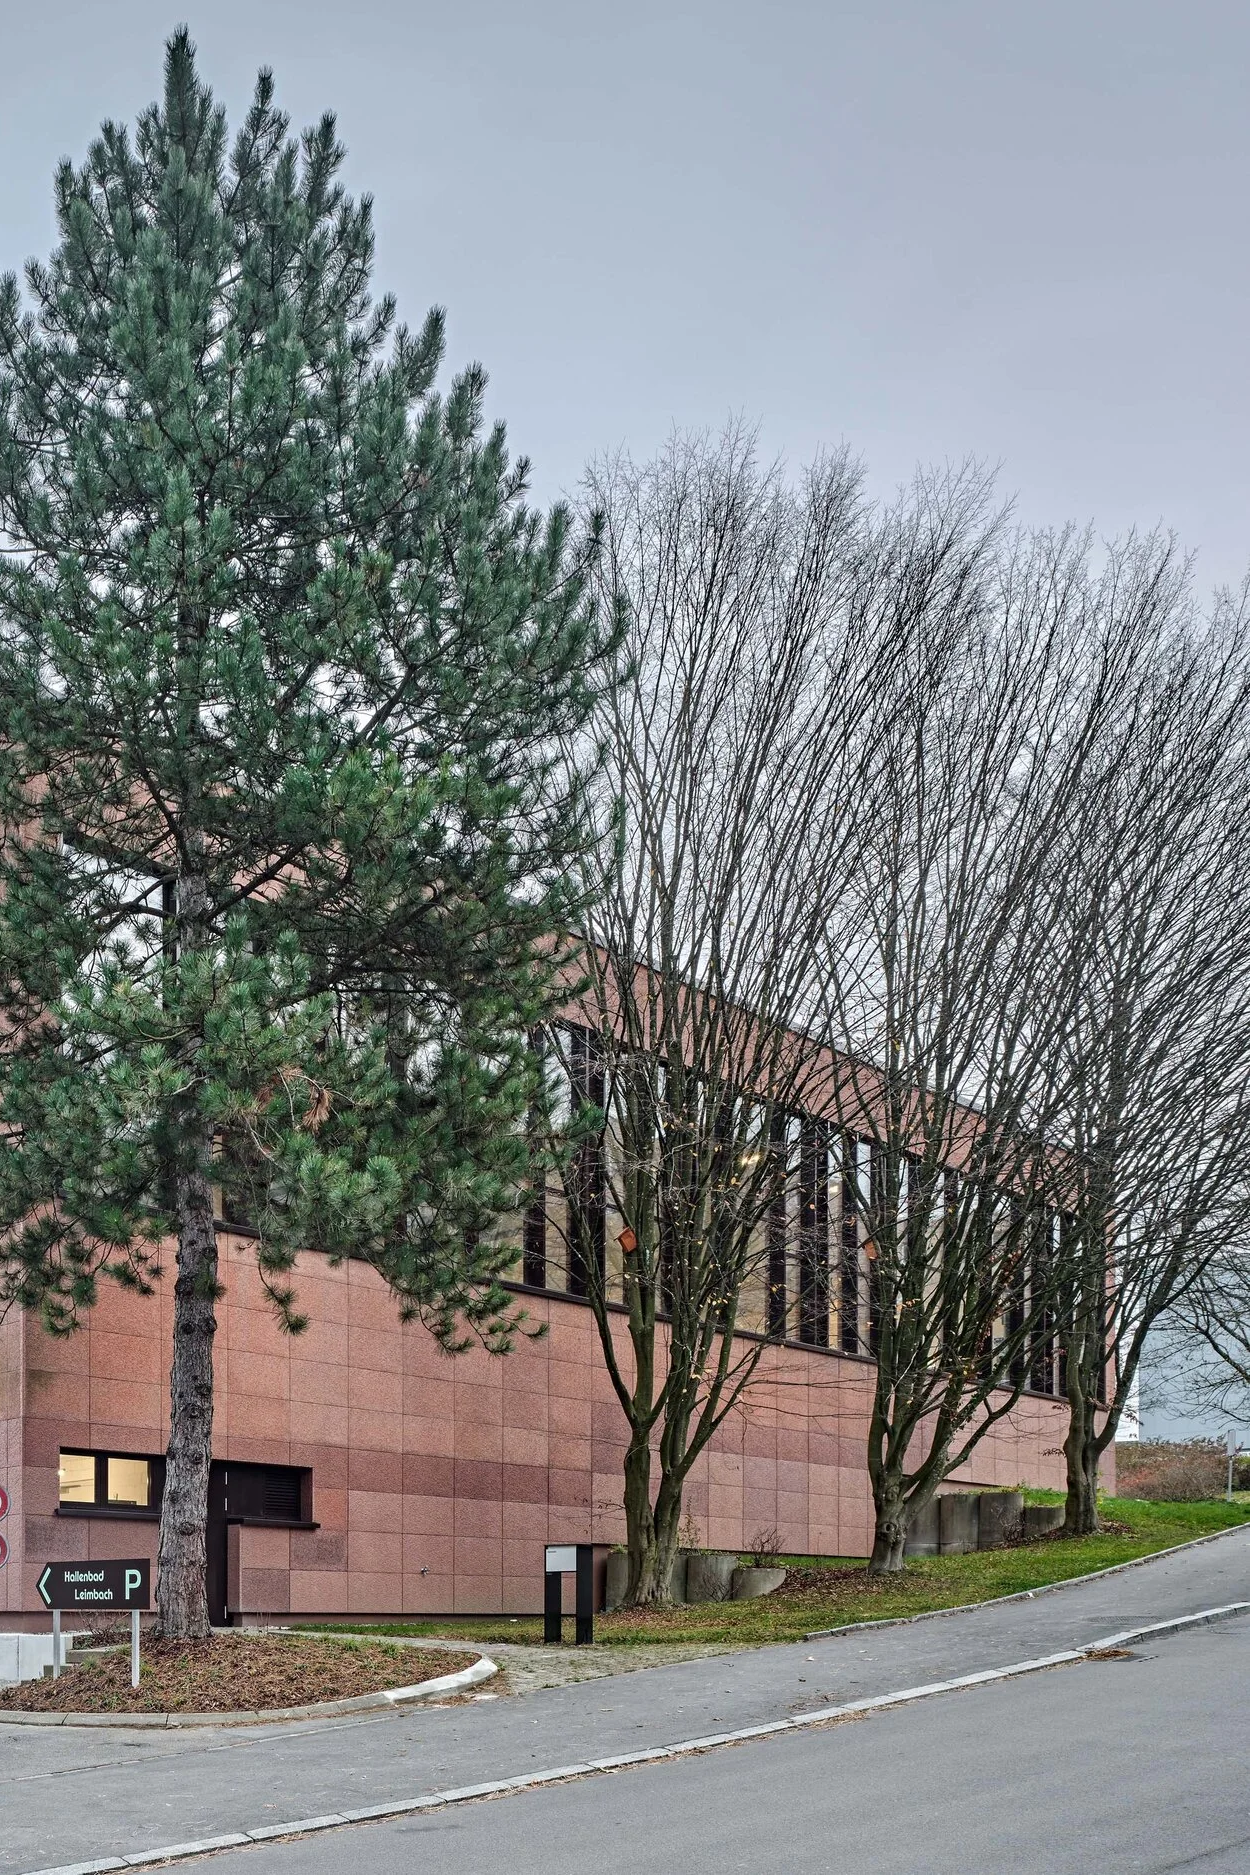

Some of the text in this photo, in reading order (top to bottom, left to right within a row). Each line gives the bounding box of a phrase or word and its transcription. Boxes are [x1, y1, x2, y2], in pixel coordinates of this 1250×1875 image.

[64, 1571, 104, 1582] Hallenbad
[125, 1569, 141, 1600] P
[75, 1589, 113, 1600] Leimbach
